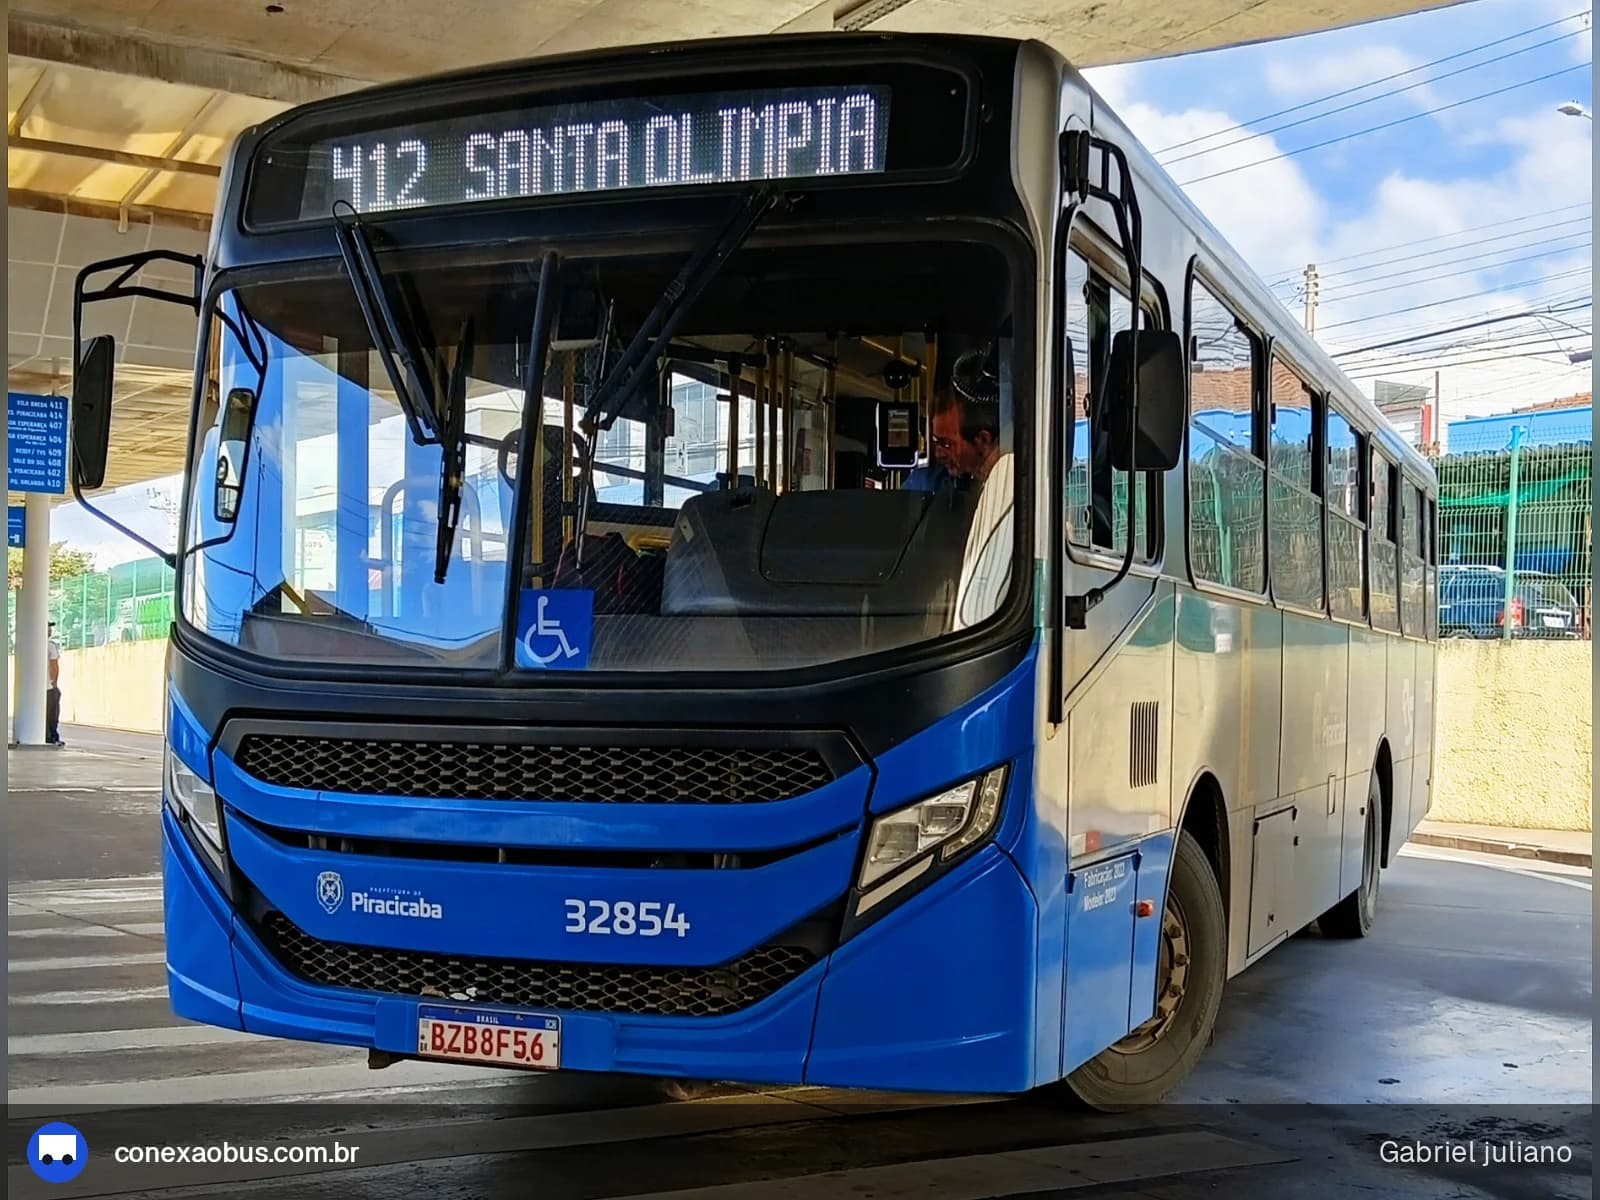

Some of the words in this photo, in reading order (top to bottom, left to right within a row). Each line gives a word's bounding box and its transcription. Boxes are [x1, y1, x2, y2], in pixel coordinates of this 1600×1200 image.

[332, 139, 426, 213] 412
[464, 119, 630, 200] SANTA
[645, 93, 875, 185] OLIMPIA
[50, 401, 63, 410] 411
[50, 411, 63, 420] 414
[50, 421, 63, 430] 407
[49, 435, 62, 444] 404
[48, 448, 62, 457] 409
[48, 458, 62, 467] 408
[47, 468, 61, 477] 402
[47, 479, 61, 488] 410
[351, 892, 442, 919] Piracicaba
[565, 899, 690, 937] 32854
[476, 1015, 499, 1024] BRASIL
[431, 1023, 543, 1061] BZB8F56
